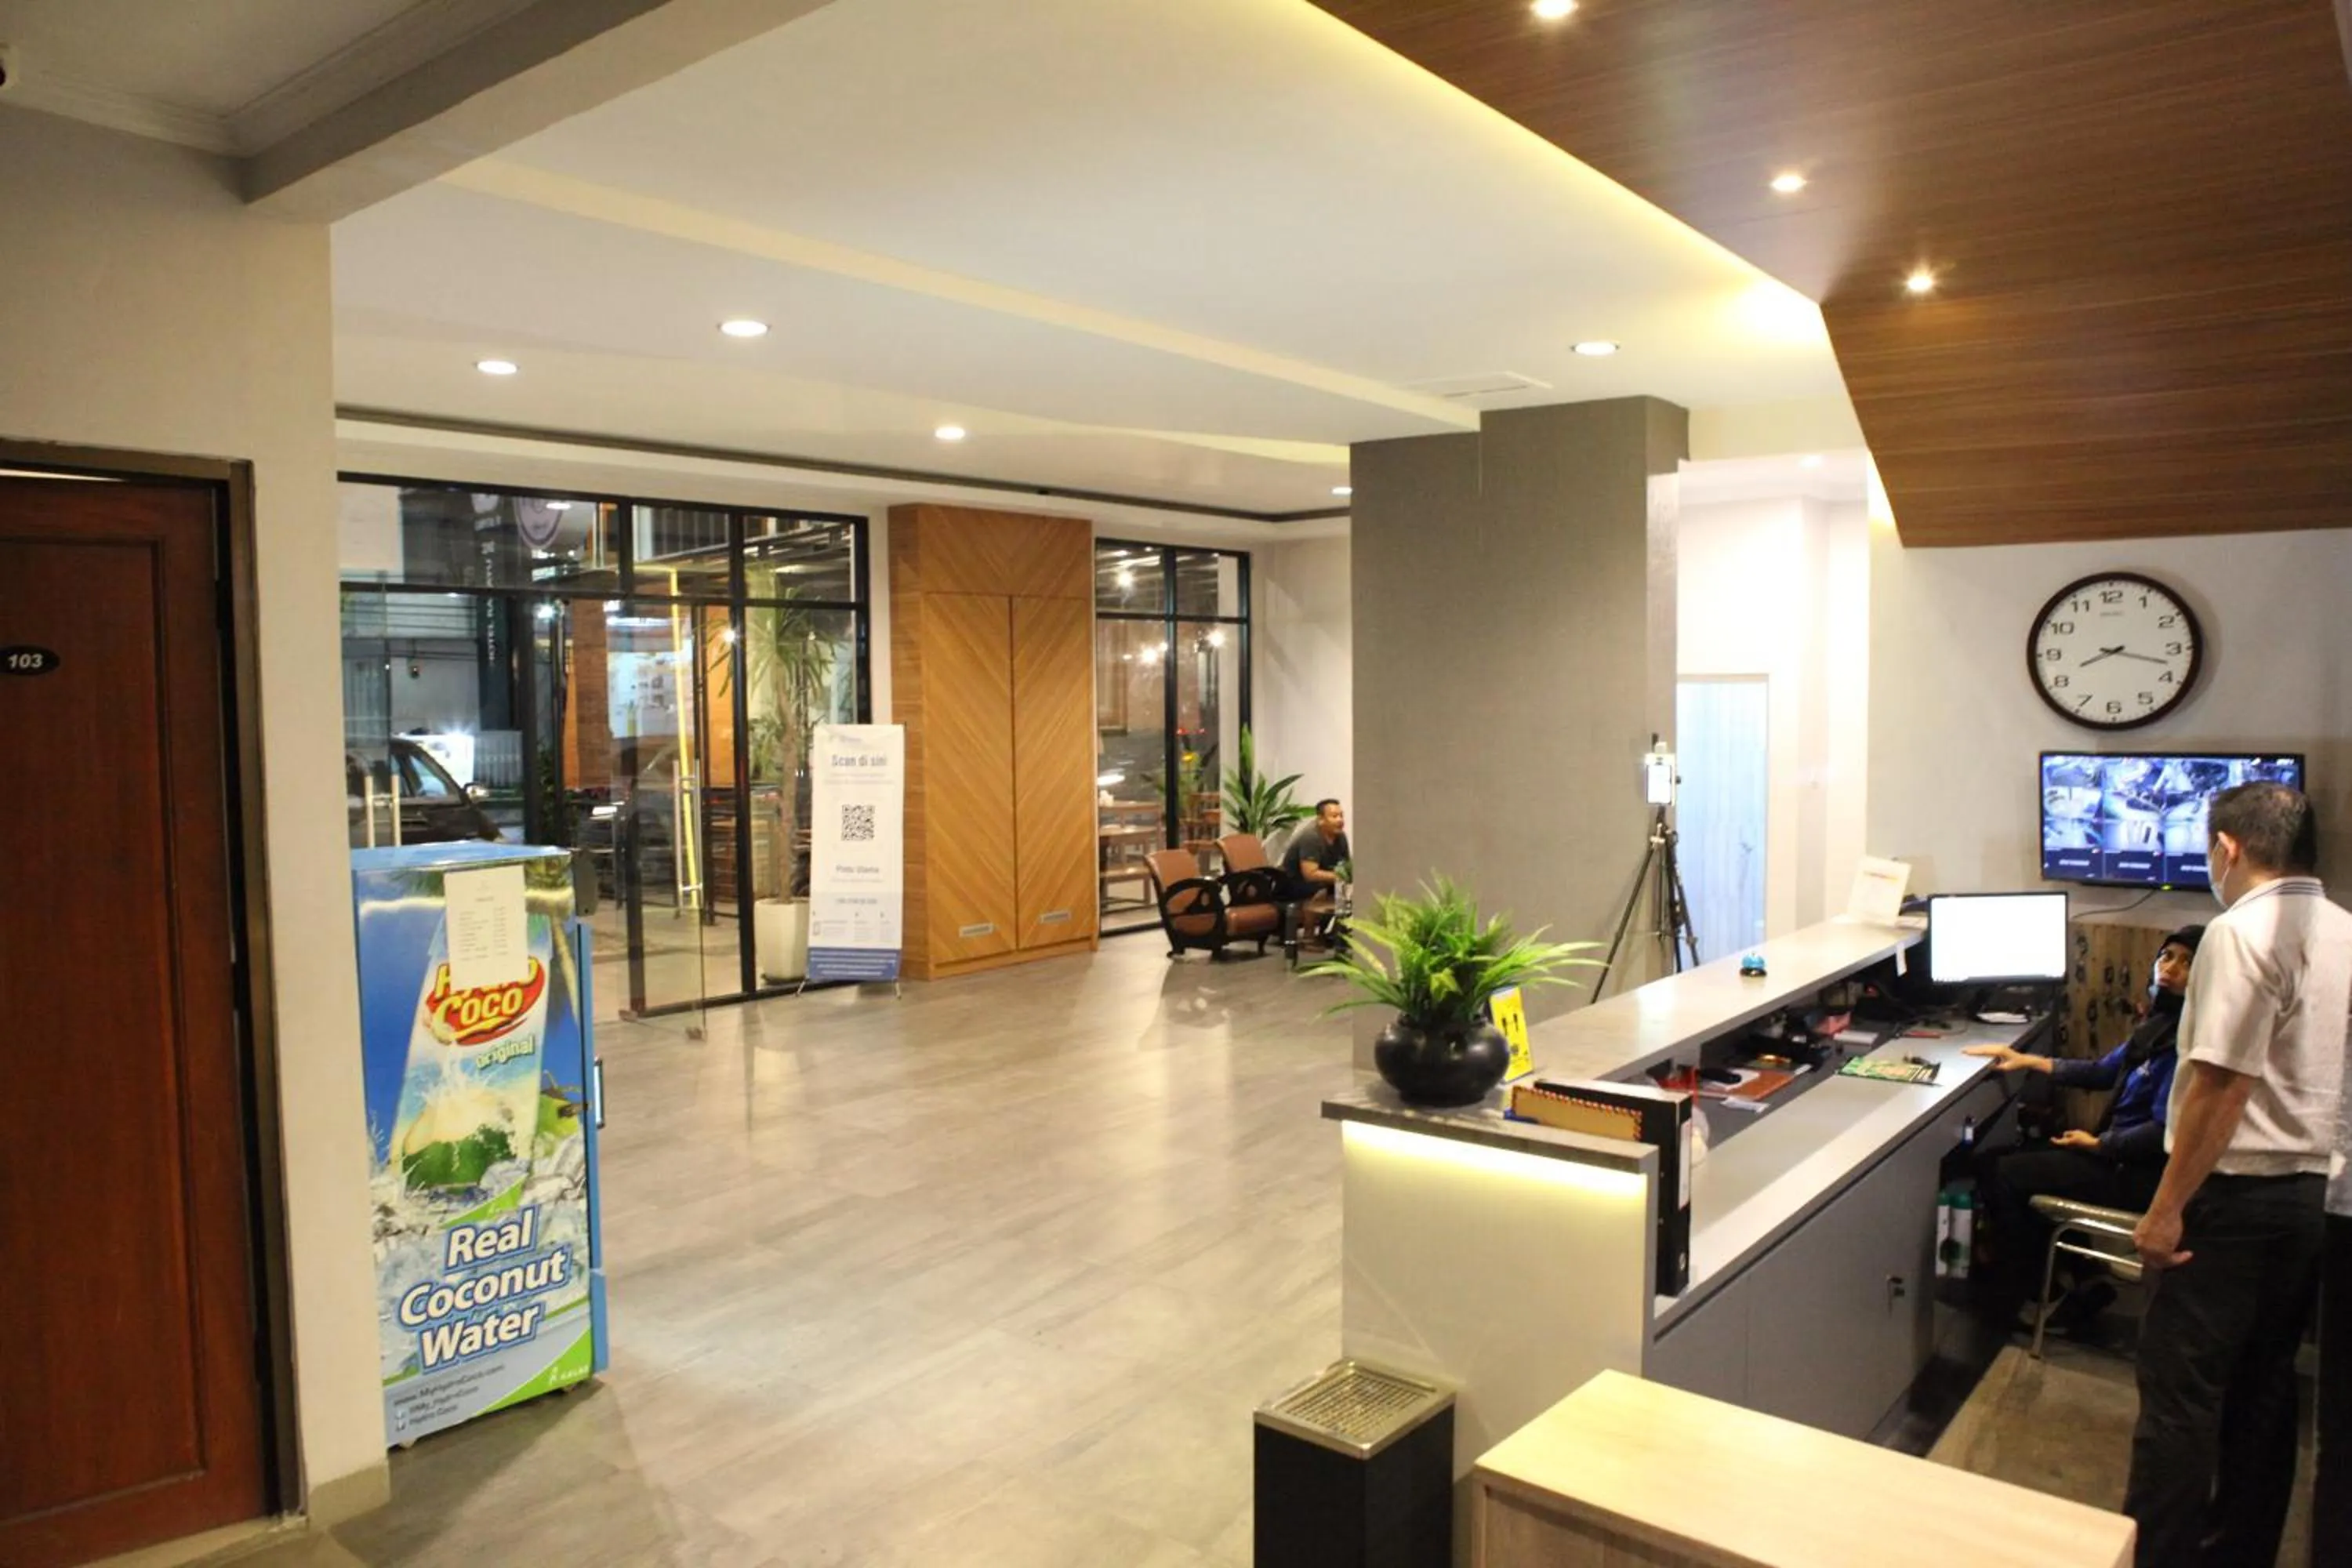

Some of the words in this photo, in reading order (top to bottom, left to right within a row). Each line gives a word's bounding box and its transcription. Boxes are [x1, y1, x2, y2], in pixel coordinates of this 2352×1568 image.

[2100, 590, 2123, 604] 12
[2139, 596, 2147, 608] 1
[2071, 600, 2090, 612] 11
[2051, 622, 2074, 634] 10
[2158, 615, 2175, 628] 2
[2046, 648, 2062, 661] 9
[2165, 642, 2182, 655] 3
[8, 654, 43, 669] 103
[2054, 675, 2070, 688] 8
[2158, 670, 2172, 684] 4
[2078, 695, 2093, 708] 7
[2137, 692, 2154, 705] 5
[2106, 701, 2122, 714] 6
[832, 754, 856, 767] Scan
[859, 754, 868, 767] di
[476, 1034, 535, 1069] original
[445, 1208, 535, 1269] Real
[399, 1249, 567, 1326] Coconut
[421, 1303, 540, 1369] Water
